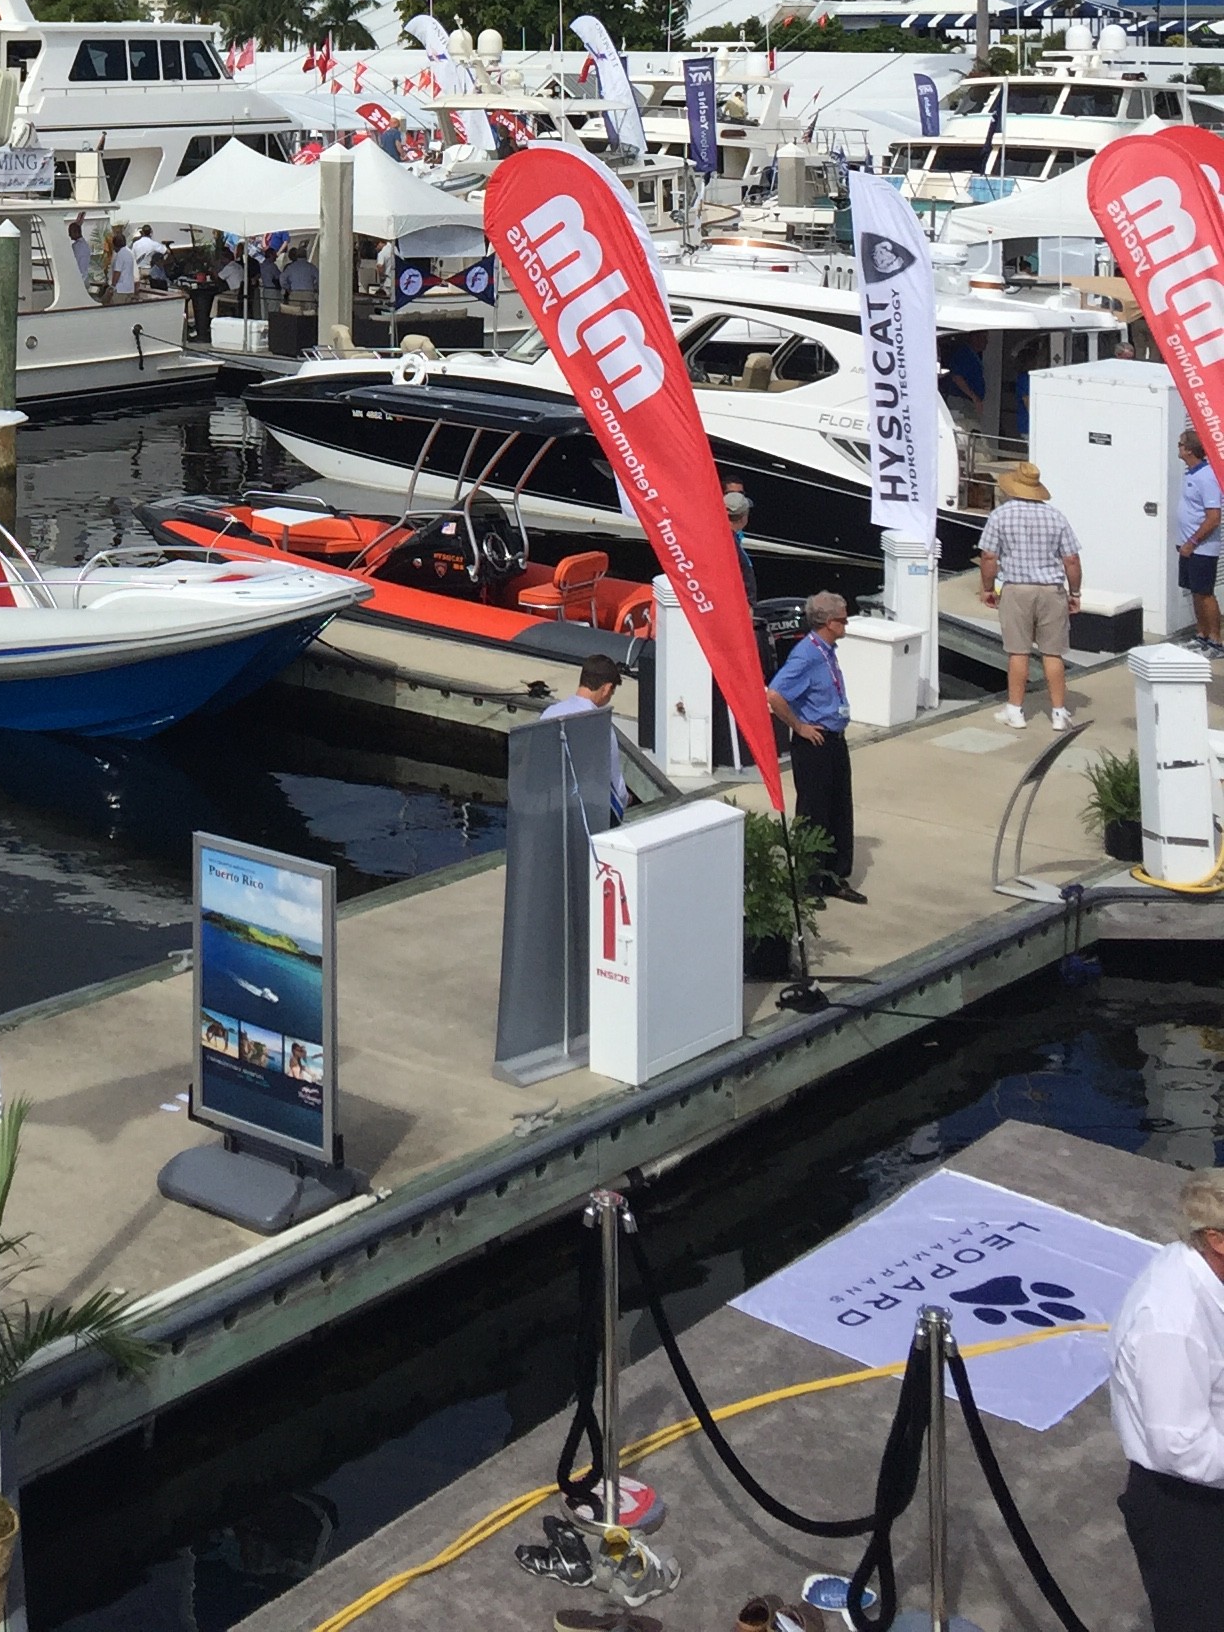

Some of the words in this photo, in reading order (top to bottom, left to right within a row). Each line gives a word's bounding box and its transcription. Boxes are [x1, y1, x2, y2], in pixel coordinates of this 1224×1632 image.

[891, 288, 909, 399] TECHNOLOGY
[818, 413, 865, 430] FLOE
[866, 293, 910, 502] HYSUCAT
[901, 404, 919, 502] HYDROFOIL
[209, 864, 240, 883] Puerto
[242, 875, 264, 889] Rico
[596, 968, 631, 985] INSIDE
[829, 1221, 990, 1304] CATAMARANS
[837, 1221, 1041, 1327] LEOPARD
